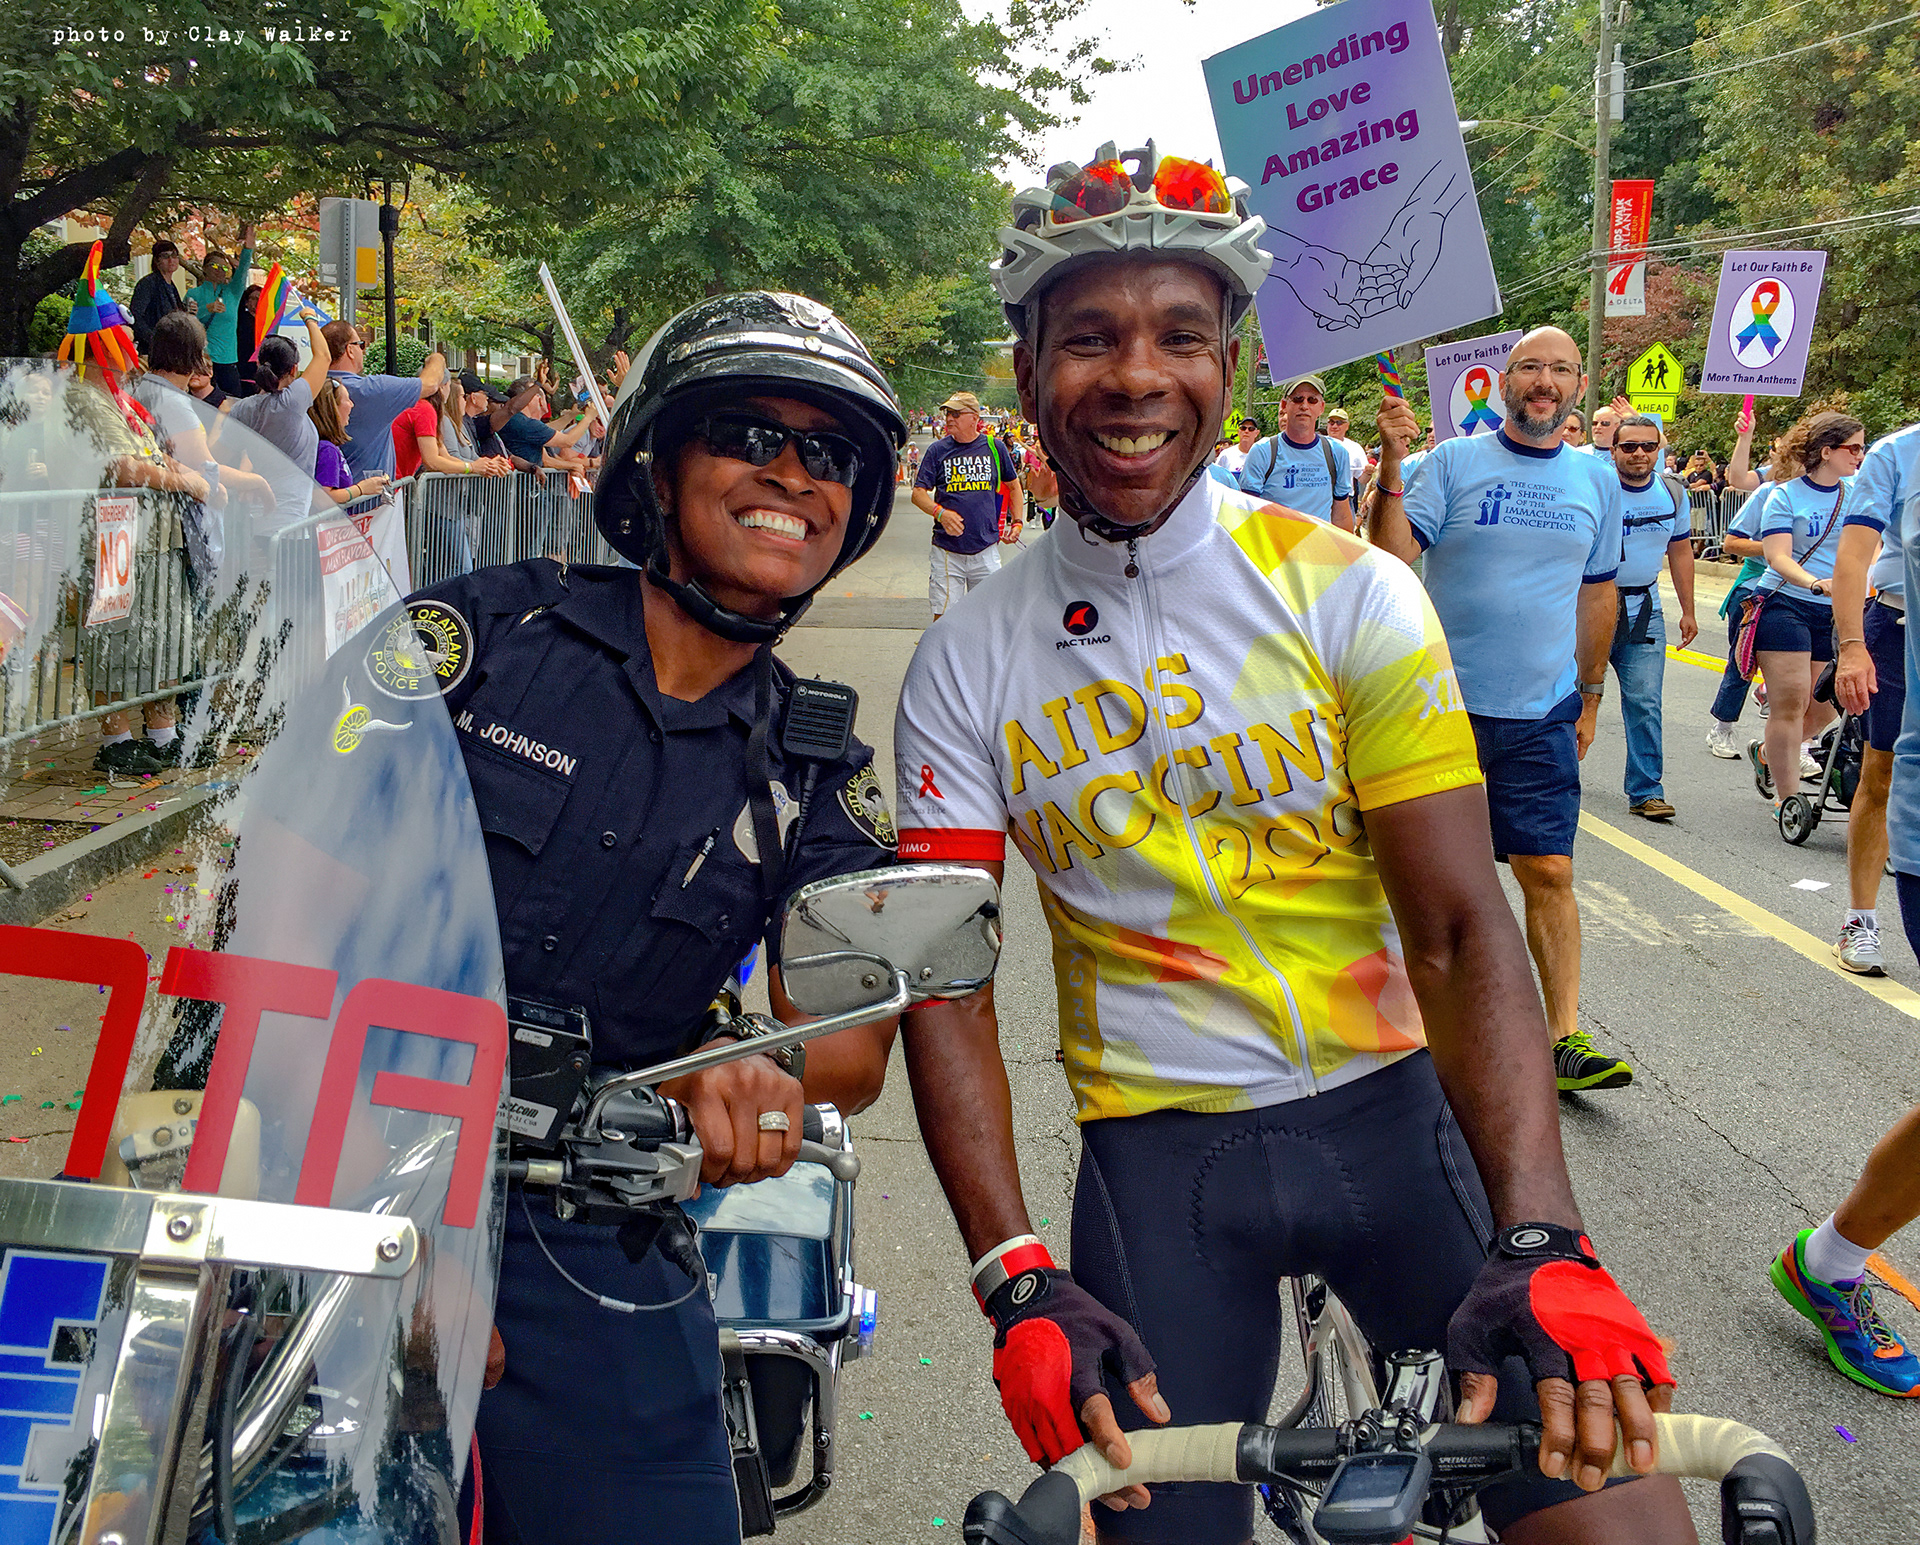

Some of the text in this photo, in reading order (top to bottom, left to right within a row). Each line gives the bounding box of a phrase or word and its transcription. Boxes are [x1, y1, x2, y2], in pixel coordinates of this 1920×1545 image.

[1232, 20, 1410, 105] Unending
[1285, 81, 1371, 131] Love
[1260, 108, 1420, 186] Amazing
[1296, 162, 1399, 213] Grace
[1615, 198, 1626, 228] WALK
[1622, 198, 1633, 251] ATLANTA
[1731, 261, 1813, 273] Let Our Faith Be
[1435, 342, 1514, 367] Let Our Faith Be
[1706, 372, 1798, 385] More Than Anthems
[1636, 403, 1670, 413] AHEAD
[943, 455, 991, 468] HUMAN
[944, 464, 992, 477] RIGHTS
[945, 473, 992, 484] CAMPAIGN
[946, 481, 990, 492] ATLANTA
[1510, 480, 1567, 495] THE CATHOLIC
[1516, 499, 1546, 509] OF THE
[1517, 490, 1557, 502] SHRINE
[1505, 506, 1576, 523] IMMACULATE
[1502, 515, 1577, 533] CONCEPTION
[100, 529, 130, 588] NO
[417, 608, 442, 620] OF
[437, 617, 462, 678] ATLANTA
[1056, 634, 1111, 651] PACTIMO
[372, 650, 419, 690] POLICE
[807, 689, 848, 701] MOTOROLA
[1003, 652, 1206, 796] AIDS
[456, 709, 577, 776] M. JOHNSON
[846, 789, 863, 816] CITY
[898, 842, 931, 853] TIMO
